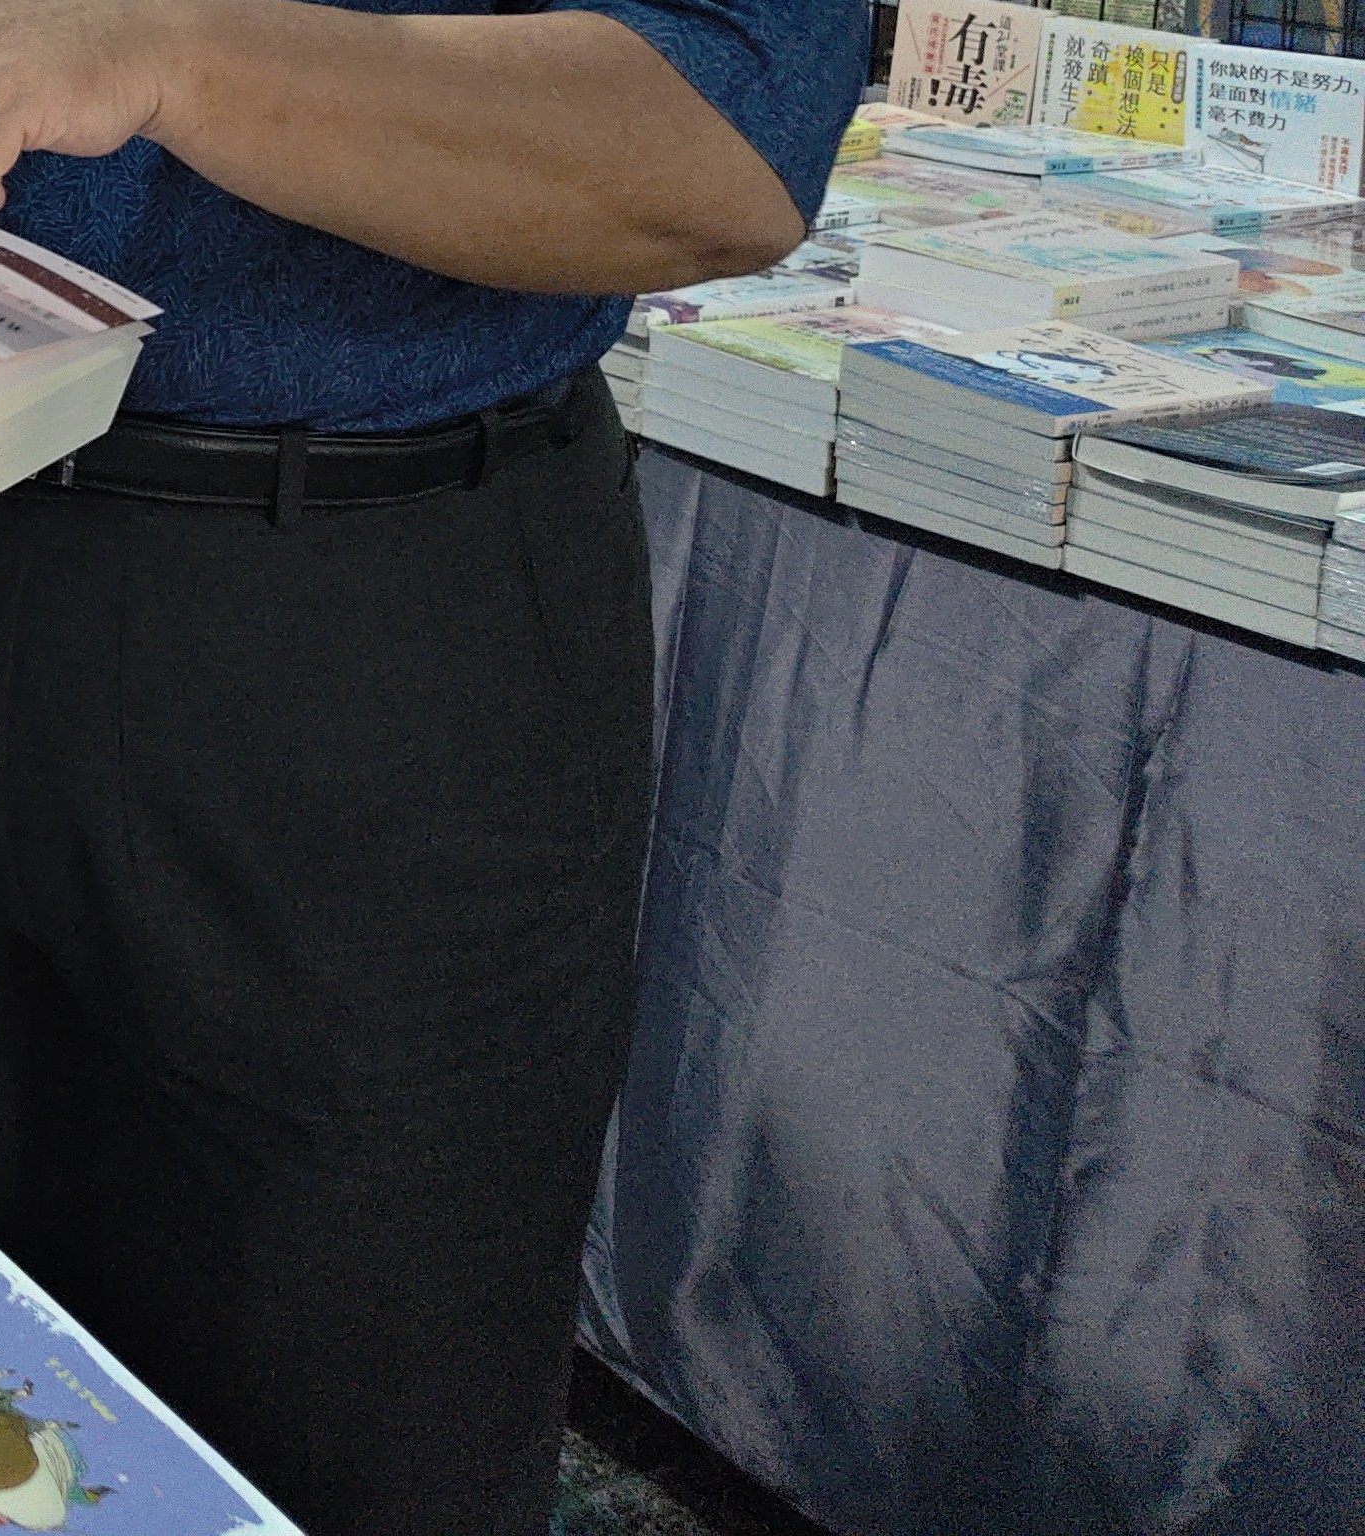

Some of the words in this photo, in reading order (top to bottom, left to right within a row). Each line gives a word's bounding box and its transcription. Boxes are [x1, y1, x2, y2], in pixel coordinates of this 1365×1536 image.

[1058, 34, 1086, 125] 就發生了
[1087, 39, 1111, 87] 奇蹟
[1146, 50, 1170, 97] 只是
[1116, 44, 1146, 138] 換個想法
[1208, 82, 1318, 114] 是面對情緒
[1207, 105, 1287, 132] 毫不費力
